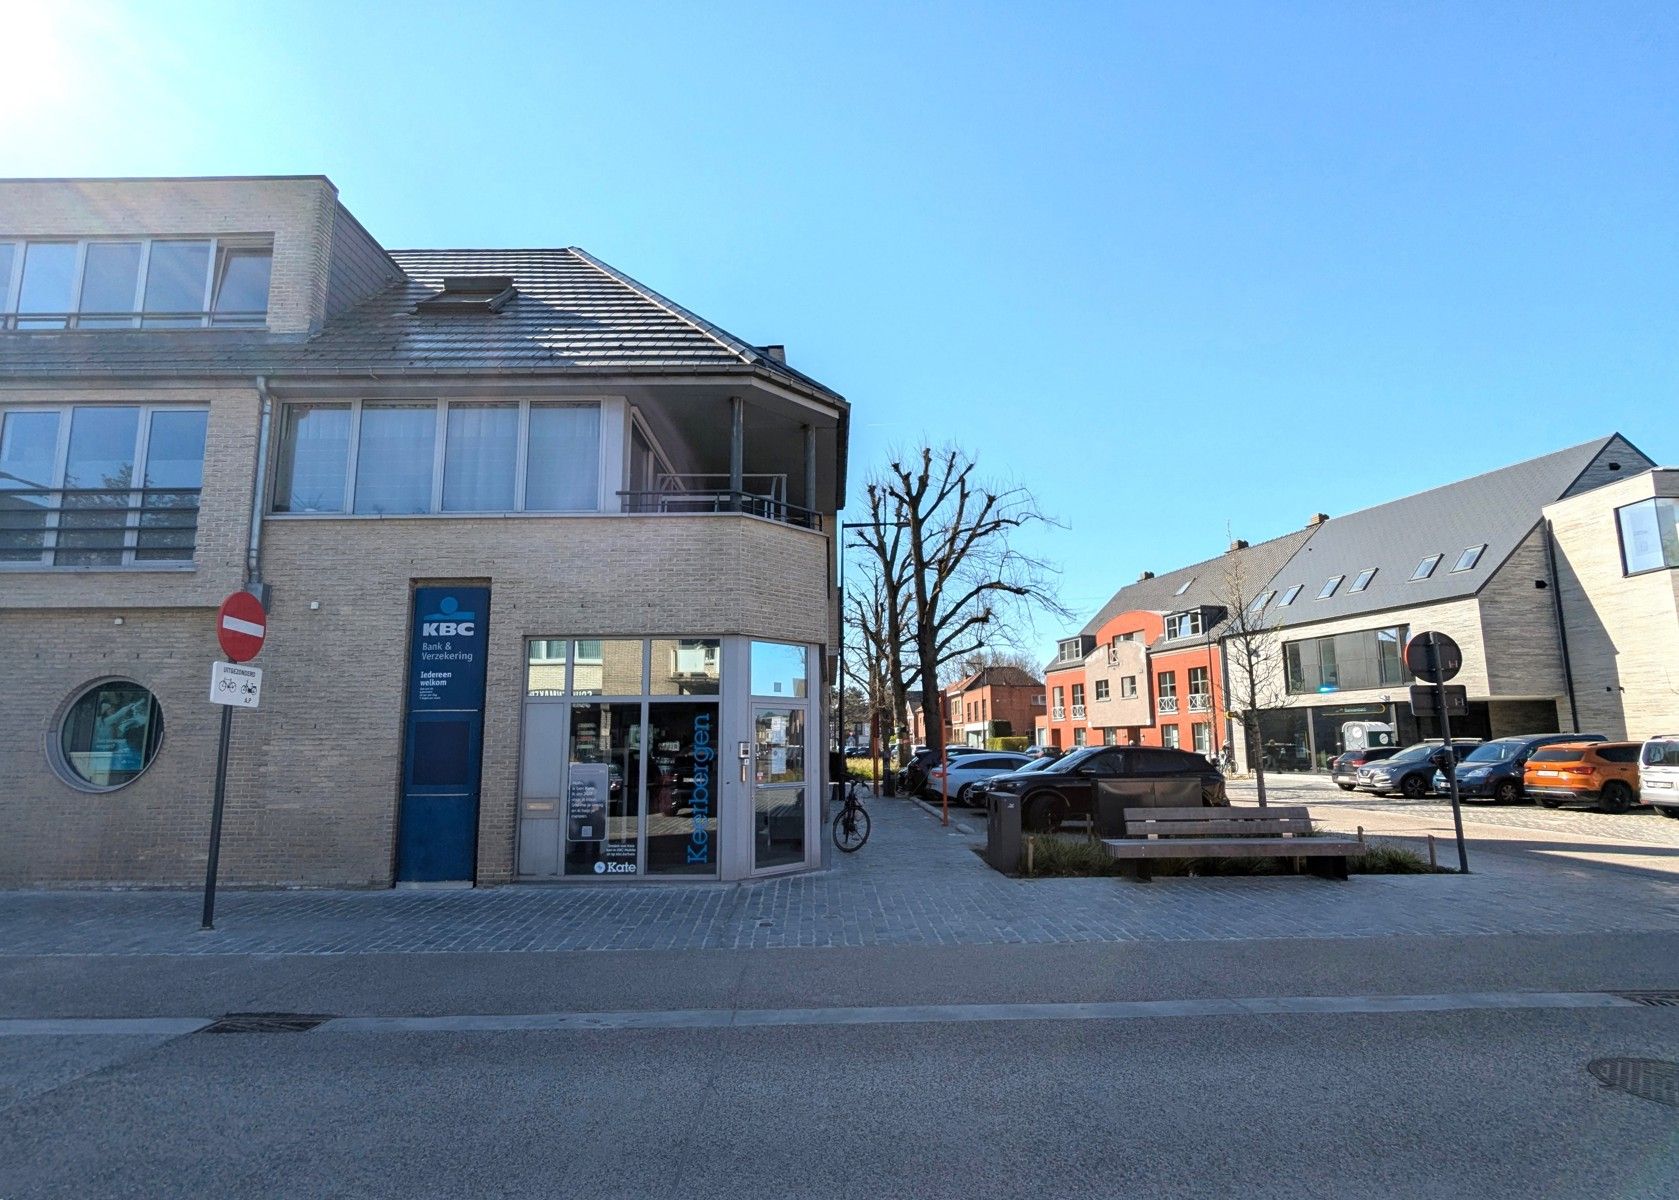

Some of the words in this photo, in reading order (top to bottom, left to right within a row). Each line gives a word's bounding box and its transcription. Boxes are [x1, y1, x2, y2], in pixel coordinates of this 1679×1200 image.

[422, 622, 475, 636] KBC
[422, 642, 443, 651] Bank
[445, 642, 452, 651] &
[421, 651, 473, 662] Verzekering
[223, 666, 256, 677] UITGEZONDERD
[420, 671, 452, 679] Iedereen
[420, 679, 447, 687] welkom
[687, 713, 714, 863] Keerbergen
[607, 861, 637, 873] Kate
